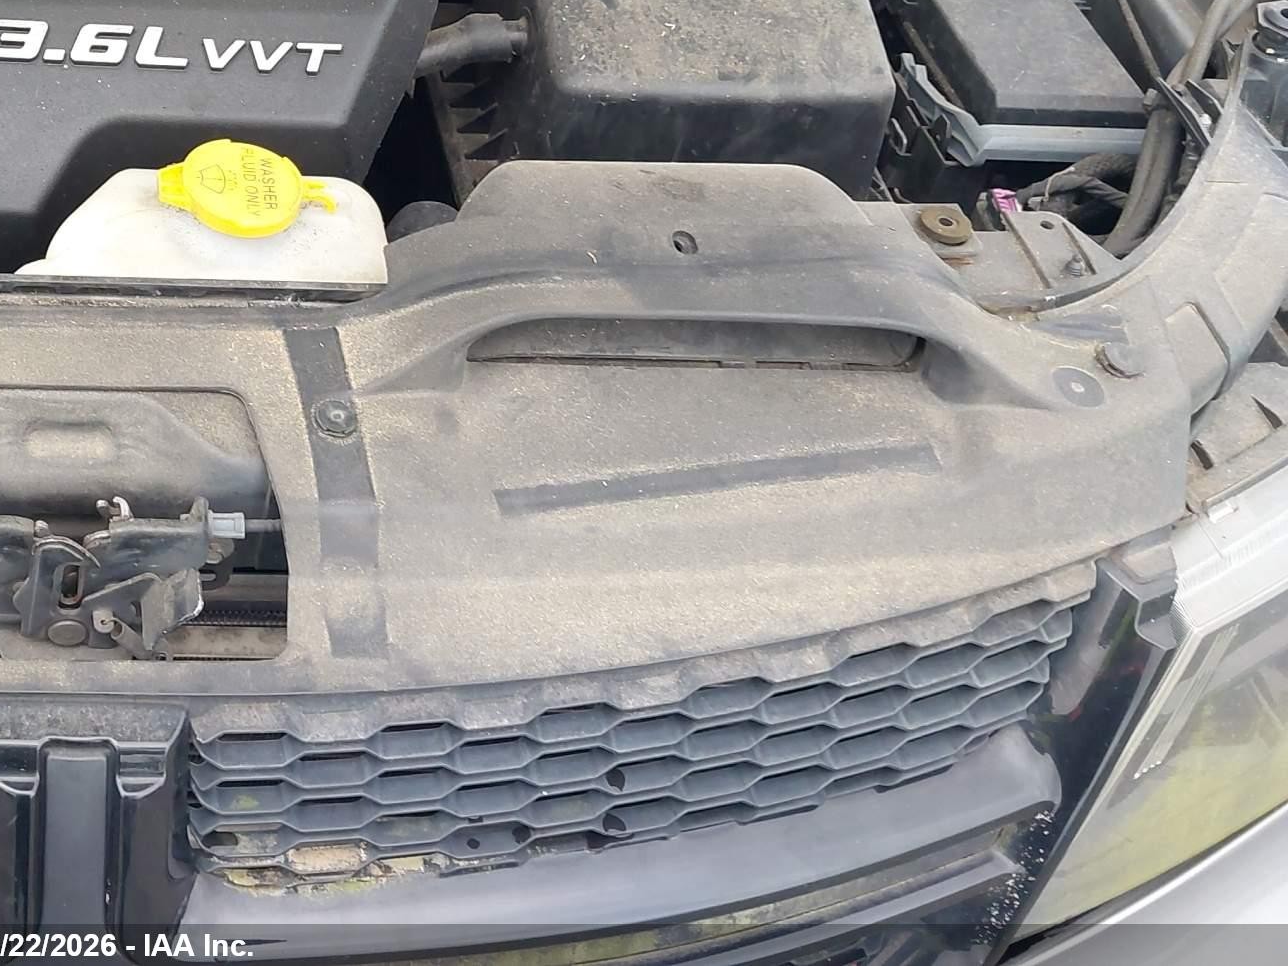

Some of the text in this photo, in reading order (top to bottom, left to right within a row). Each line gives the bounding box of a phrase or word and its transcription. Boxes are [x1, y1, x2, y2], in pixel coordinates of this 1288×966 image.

[202, 37, 344, 75] VVT
[240, 146, 261, 217] FLUID ONLY
[260, 157, 279, 211] WASHER
